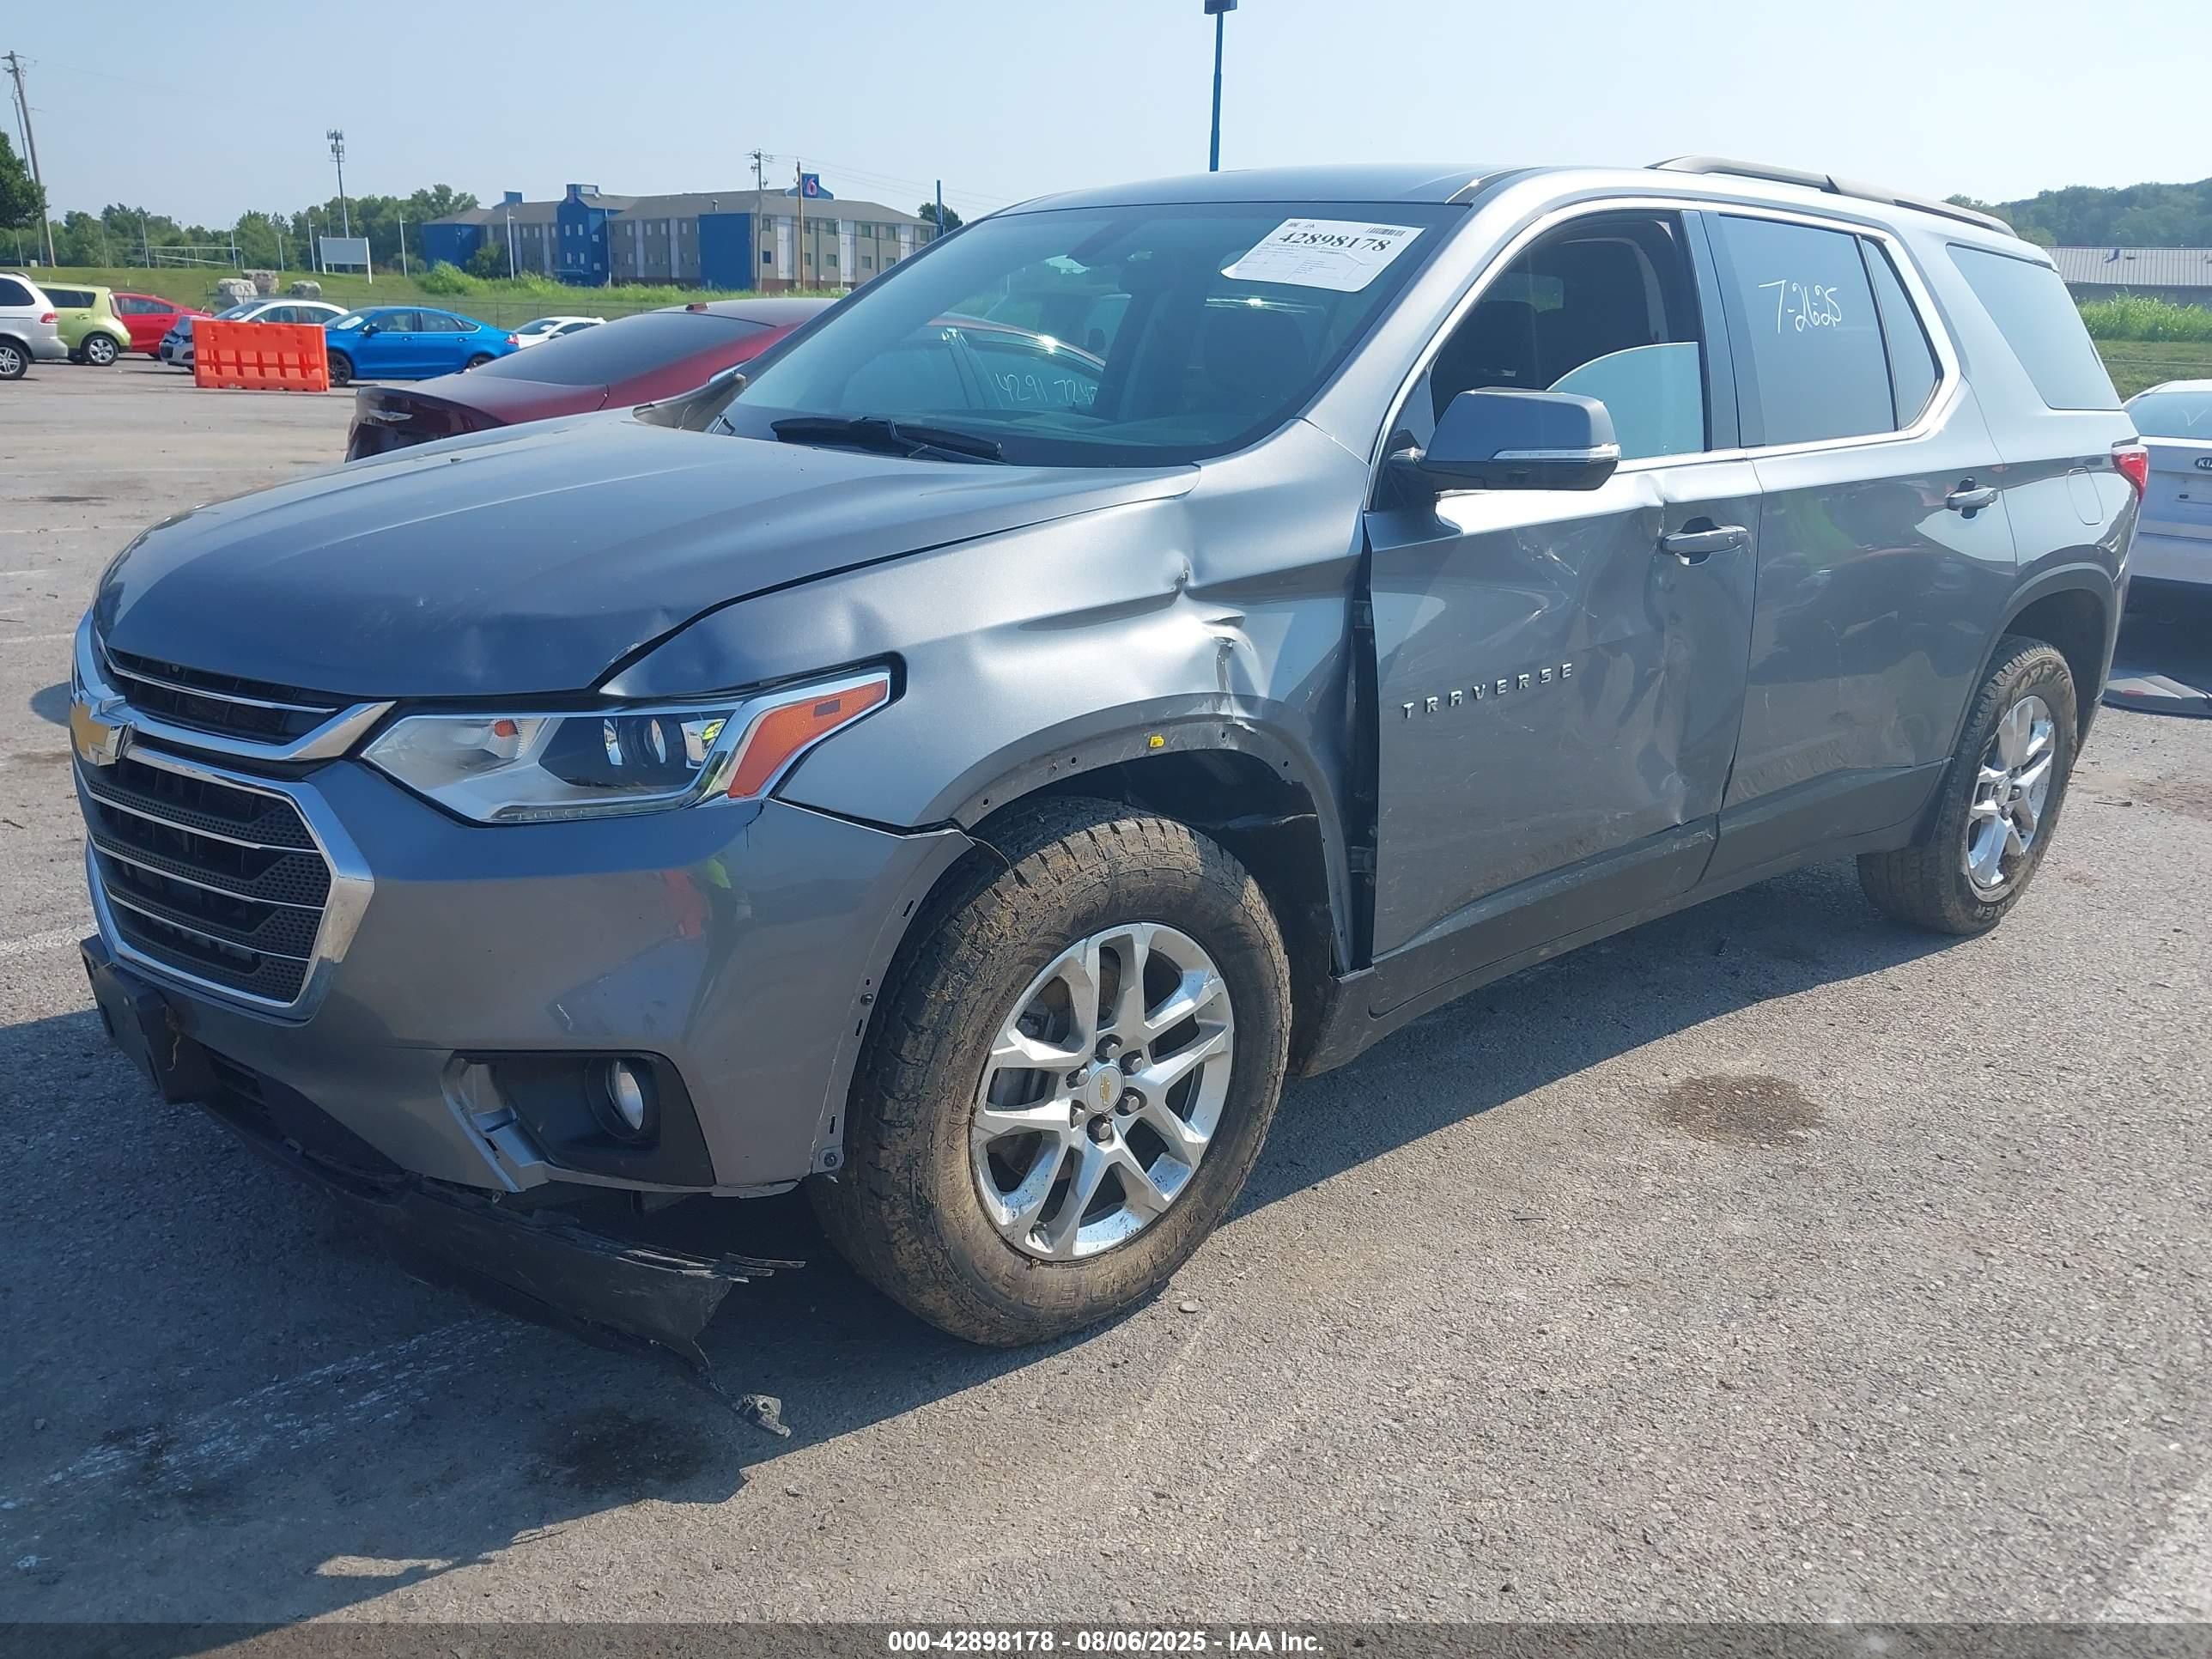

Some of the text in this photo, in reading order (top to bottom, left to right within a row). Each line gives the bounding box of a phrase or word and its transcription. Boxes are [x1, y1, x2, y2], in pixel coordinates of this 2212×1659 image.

[1279, 232, 1391, 252] 42898178
[995, 372, 1048, 403] 4291
[1401, 662, 1573, 720] TRAVERSE
